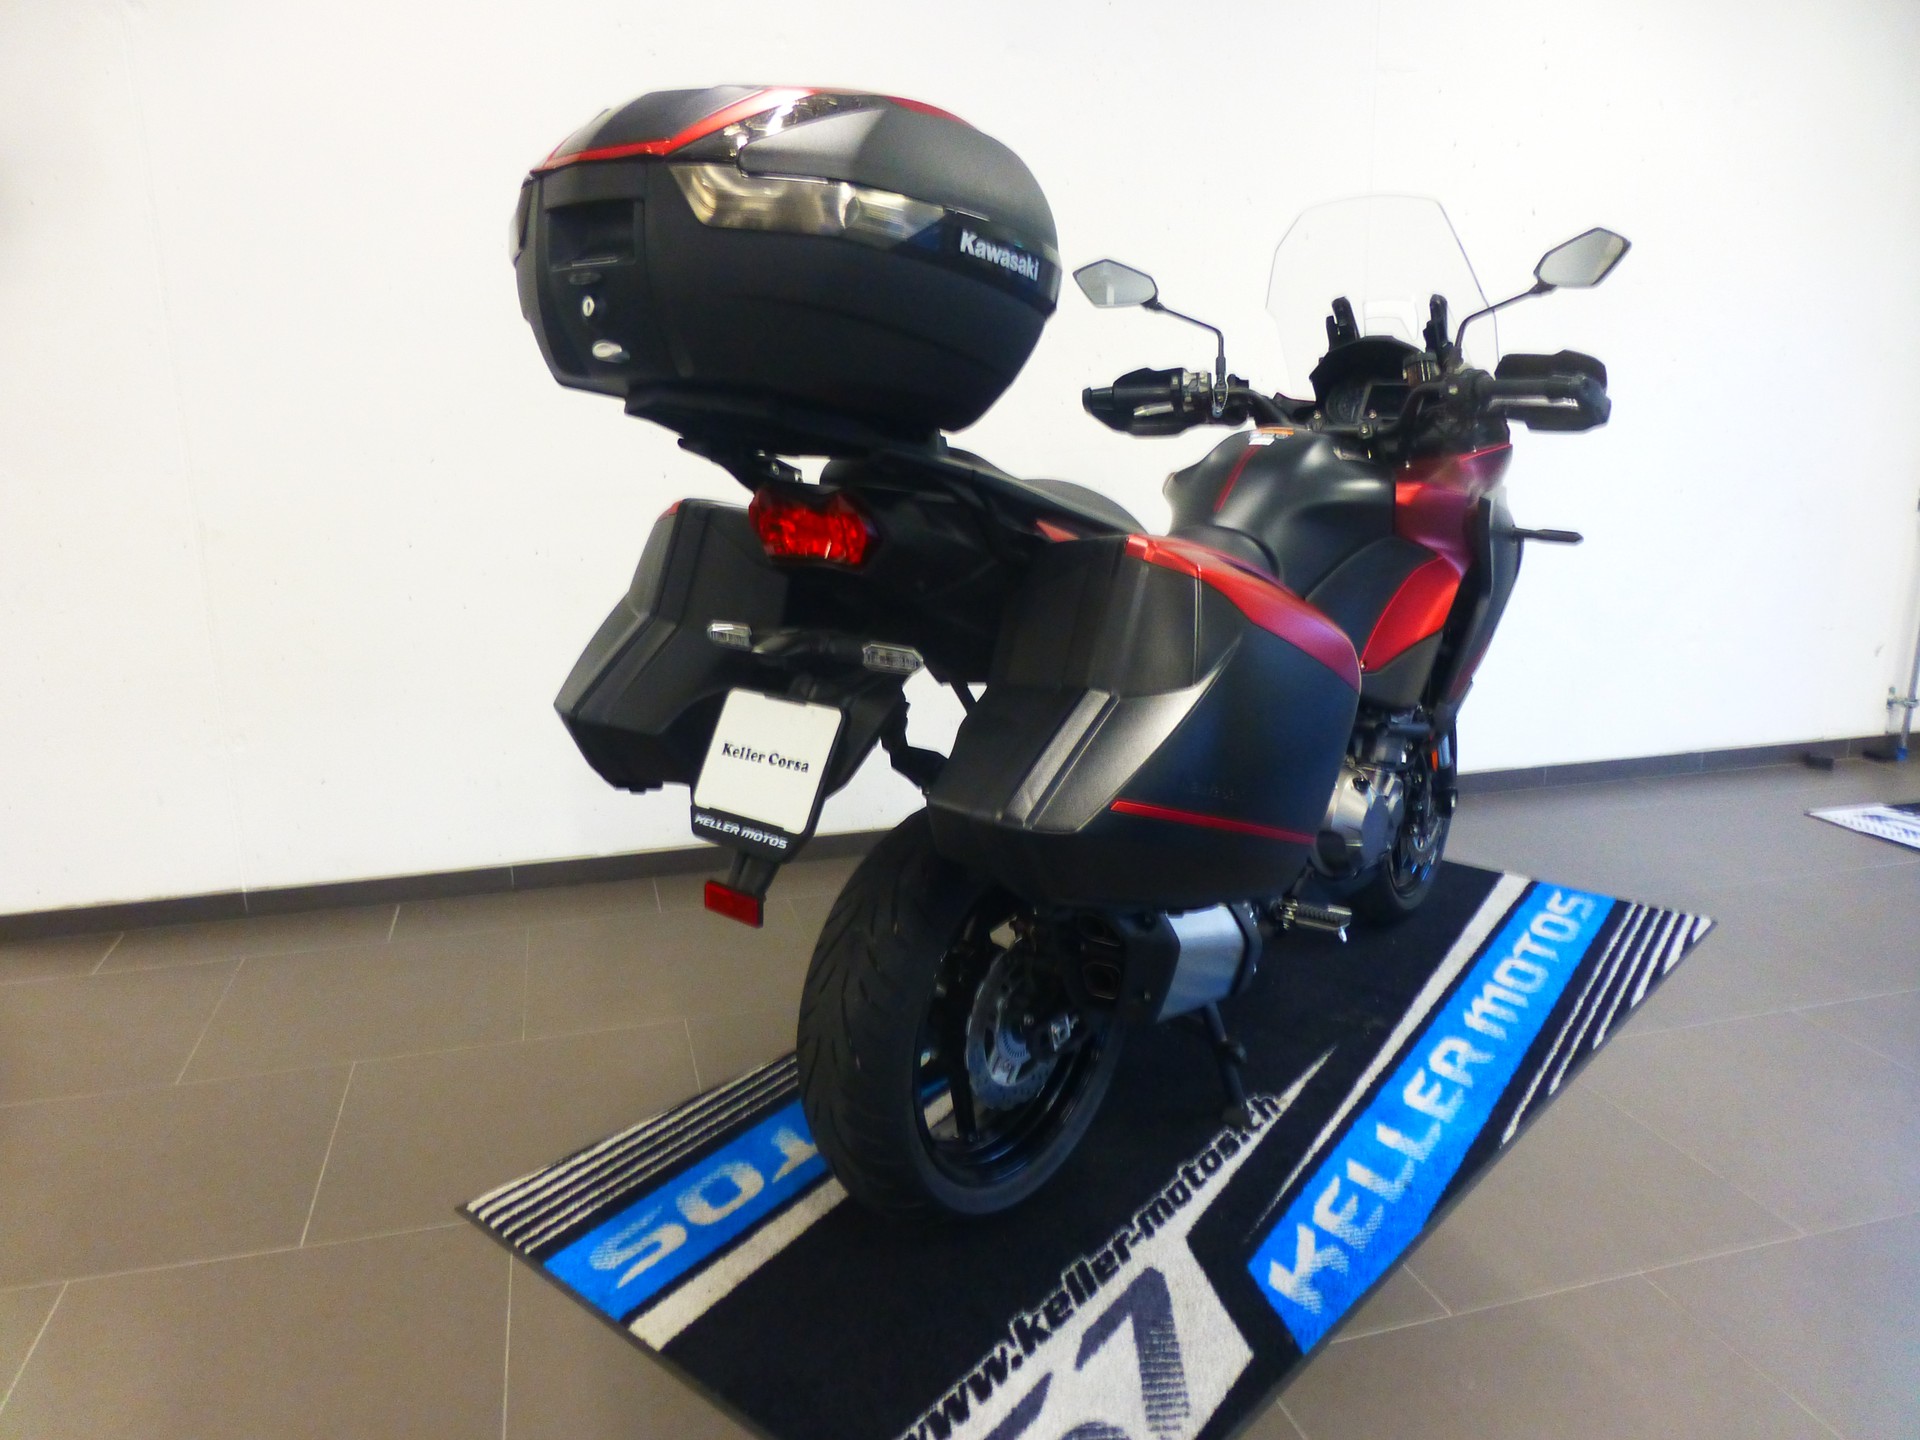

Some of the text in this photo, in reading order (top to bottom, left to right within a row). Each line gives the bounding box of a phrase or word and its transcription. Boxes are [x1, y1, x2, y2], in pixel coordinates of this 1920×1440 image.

[960, 229, 1040, 282] Kawasaki
[721, 742, 810, 773] Keller Corsa
[694, 814, 788, 850] KELLER MOTOS
[1268, 890, 1597, 1315] KELLER MOTOS
